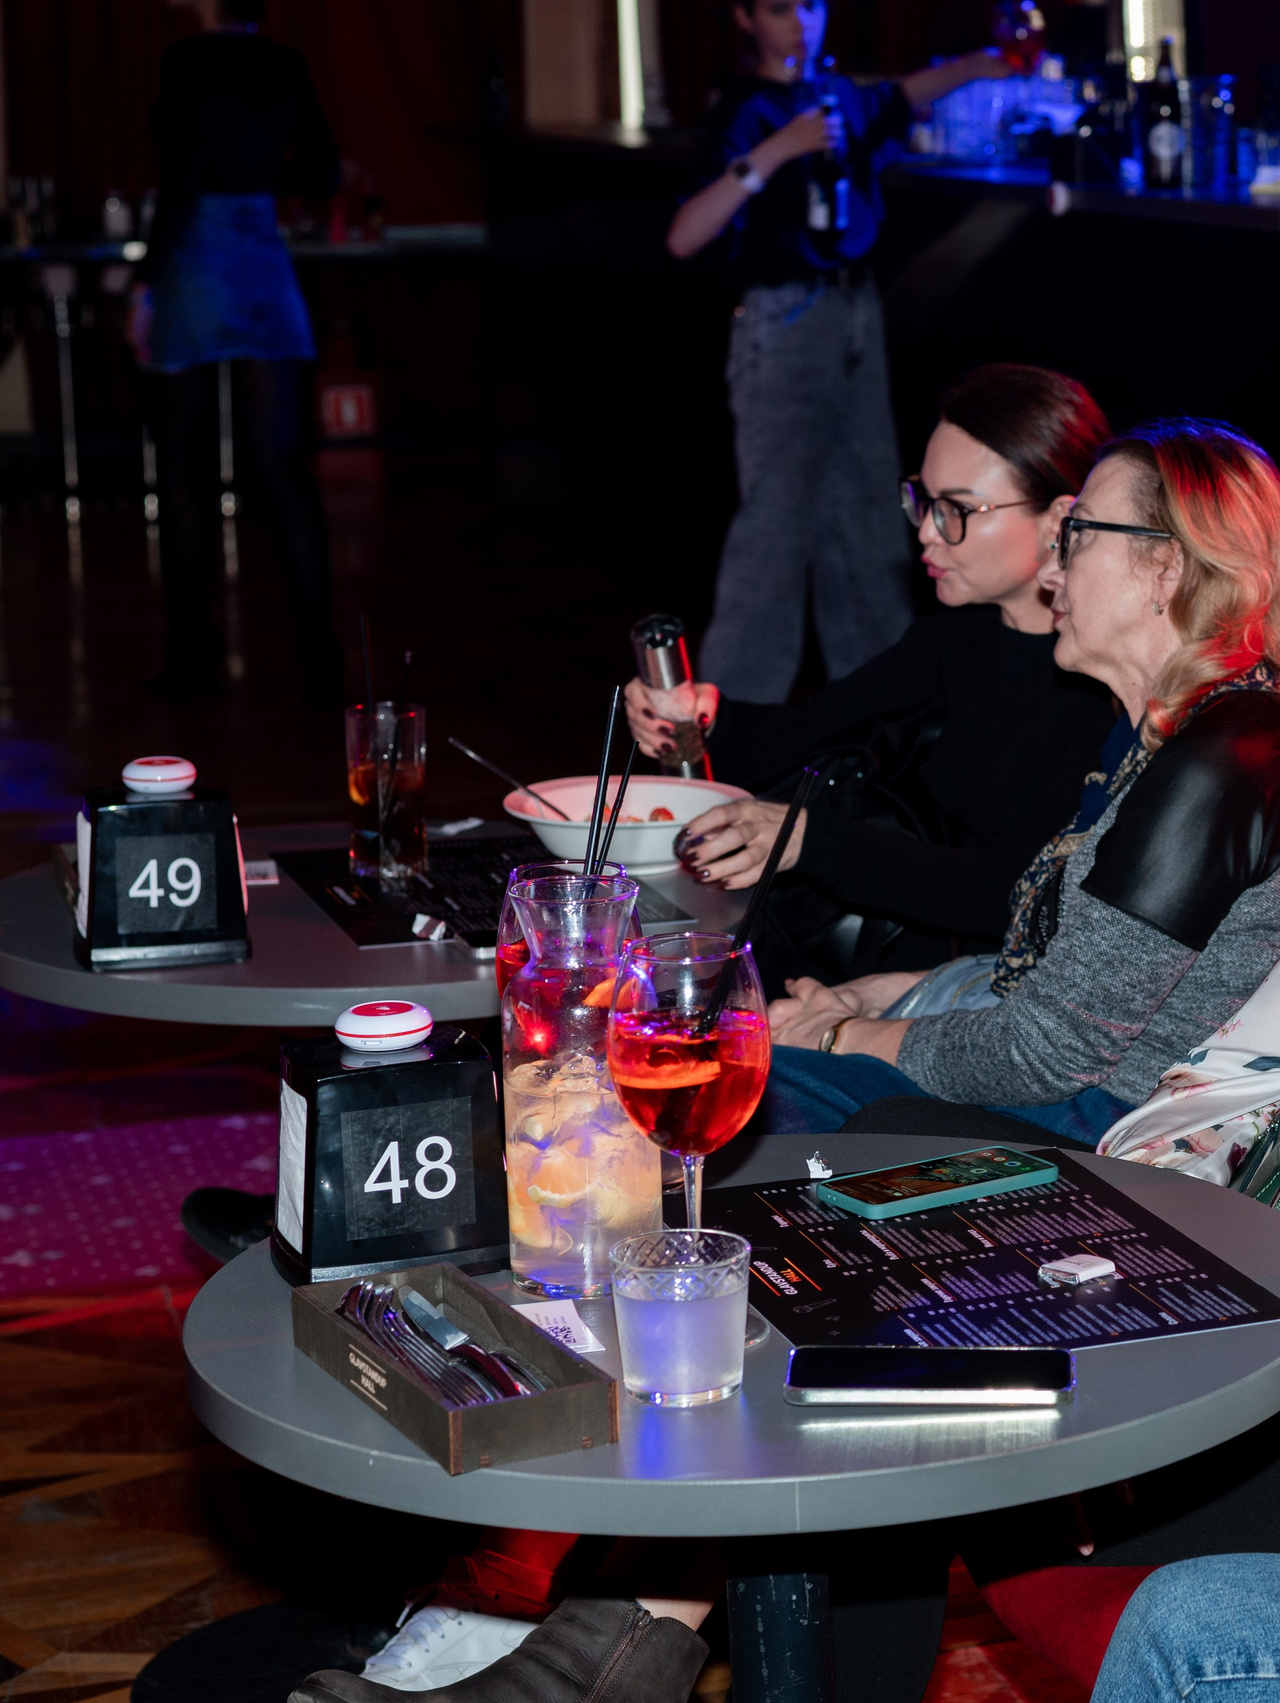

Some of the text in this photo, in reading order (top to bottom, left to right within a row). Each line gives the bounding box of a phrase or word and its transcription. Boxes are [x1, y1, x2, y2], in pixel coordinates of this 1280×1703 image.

[128, 857, 202, 908] 49
[363, 1135, 457, 1204] 48
[753, 1261, 798, 1295] GLAVSTANDUP
[780, 1268, 802, 1283] HALL
[349, 1352, 387, 1389] GLAVSTANDUP
[361, 1374, 376, 1394] HALL
